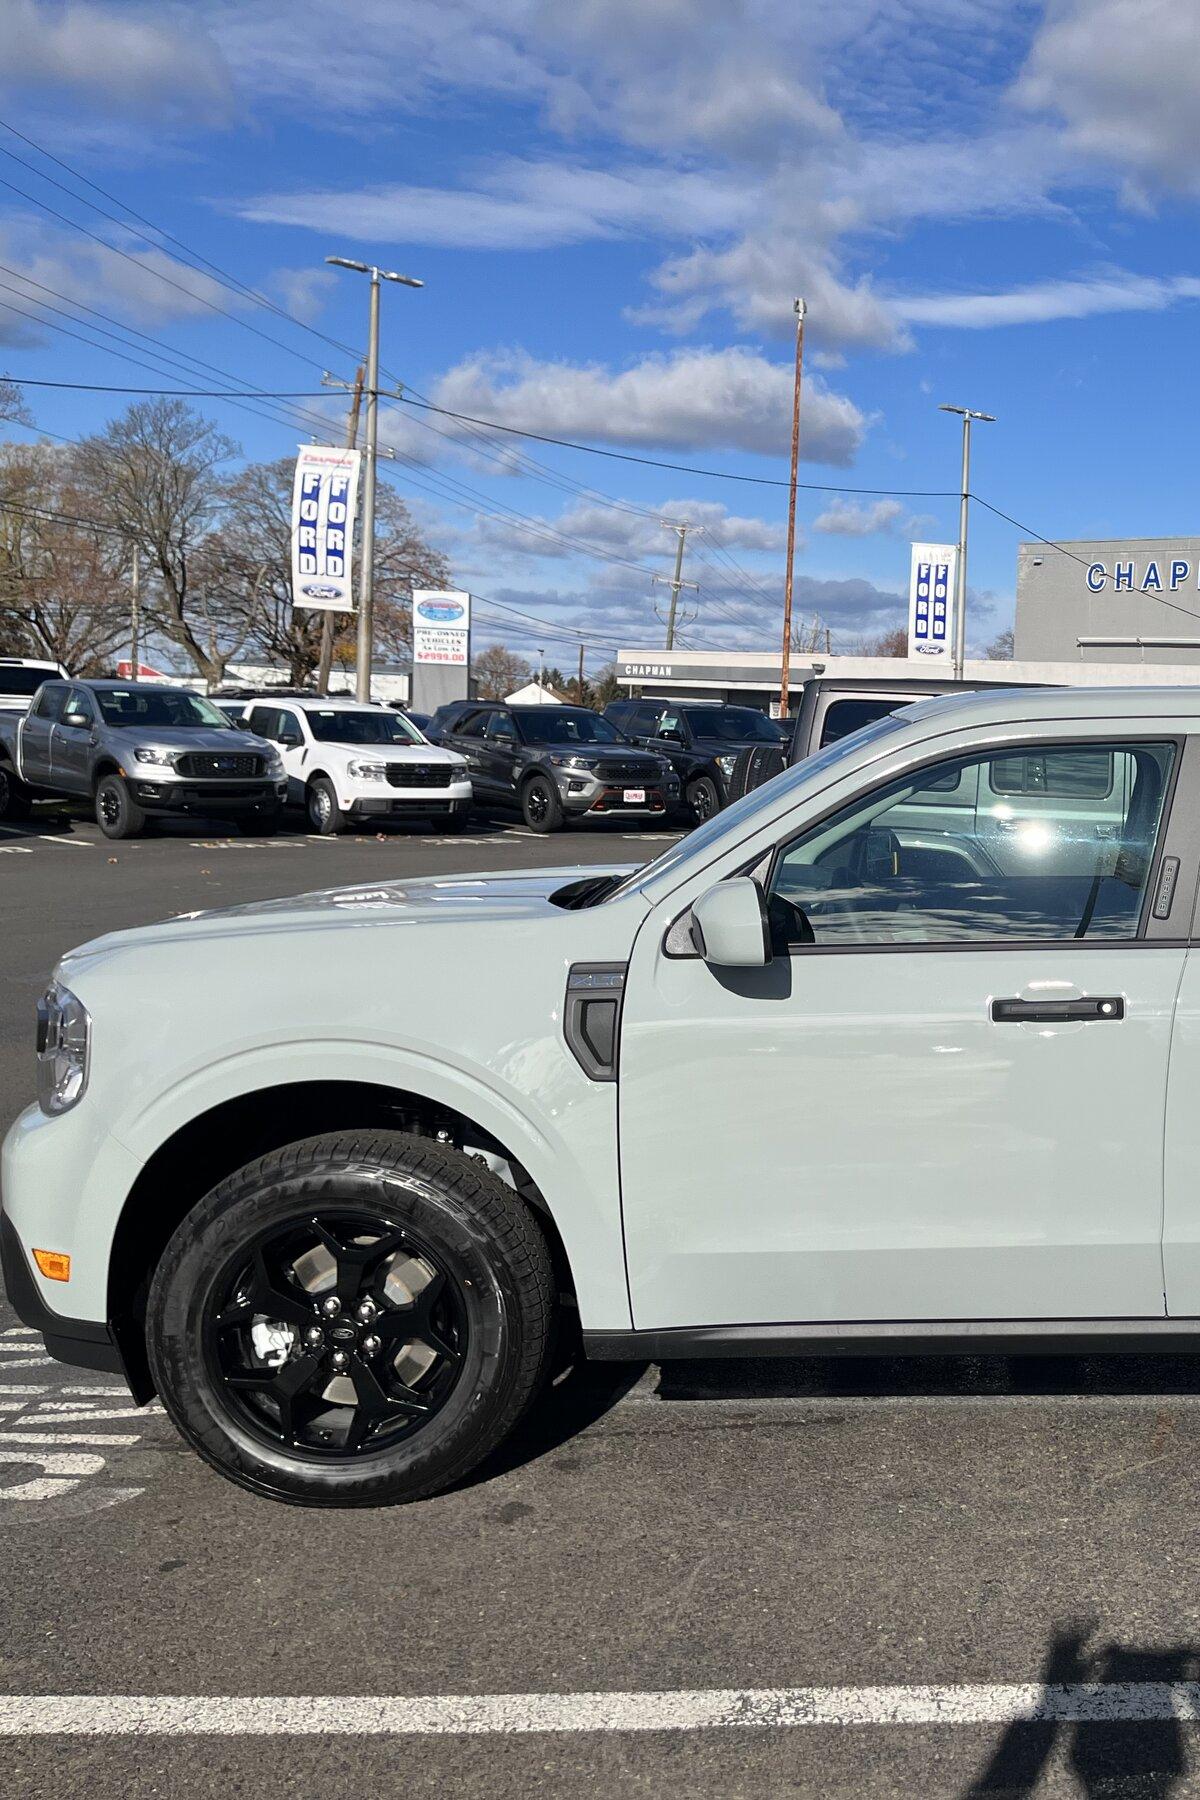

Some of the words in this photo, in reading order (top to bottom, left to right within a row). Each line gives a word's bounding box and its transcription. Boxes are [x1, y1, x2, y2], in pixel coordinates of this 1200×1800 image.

[300, 473, 320, 575] FORD
[327, 477, 347, 577] FORD
[416, 629, 466, 637] PRE-OWNED
[916, 563, 929, 634] FORD
[934, 565, 946, 635] FORD
[421, 637, 462, 645] VEHICLES
[625, 665, 672, 676] CHAPMAN
